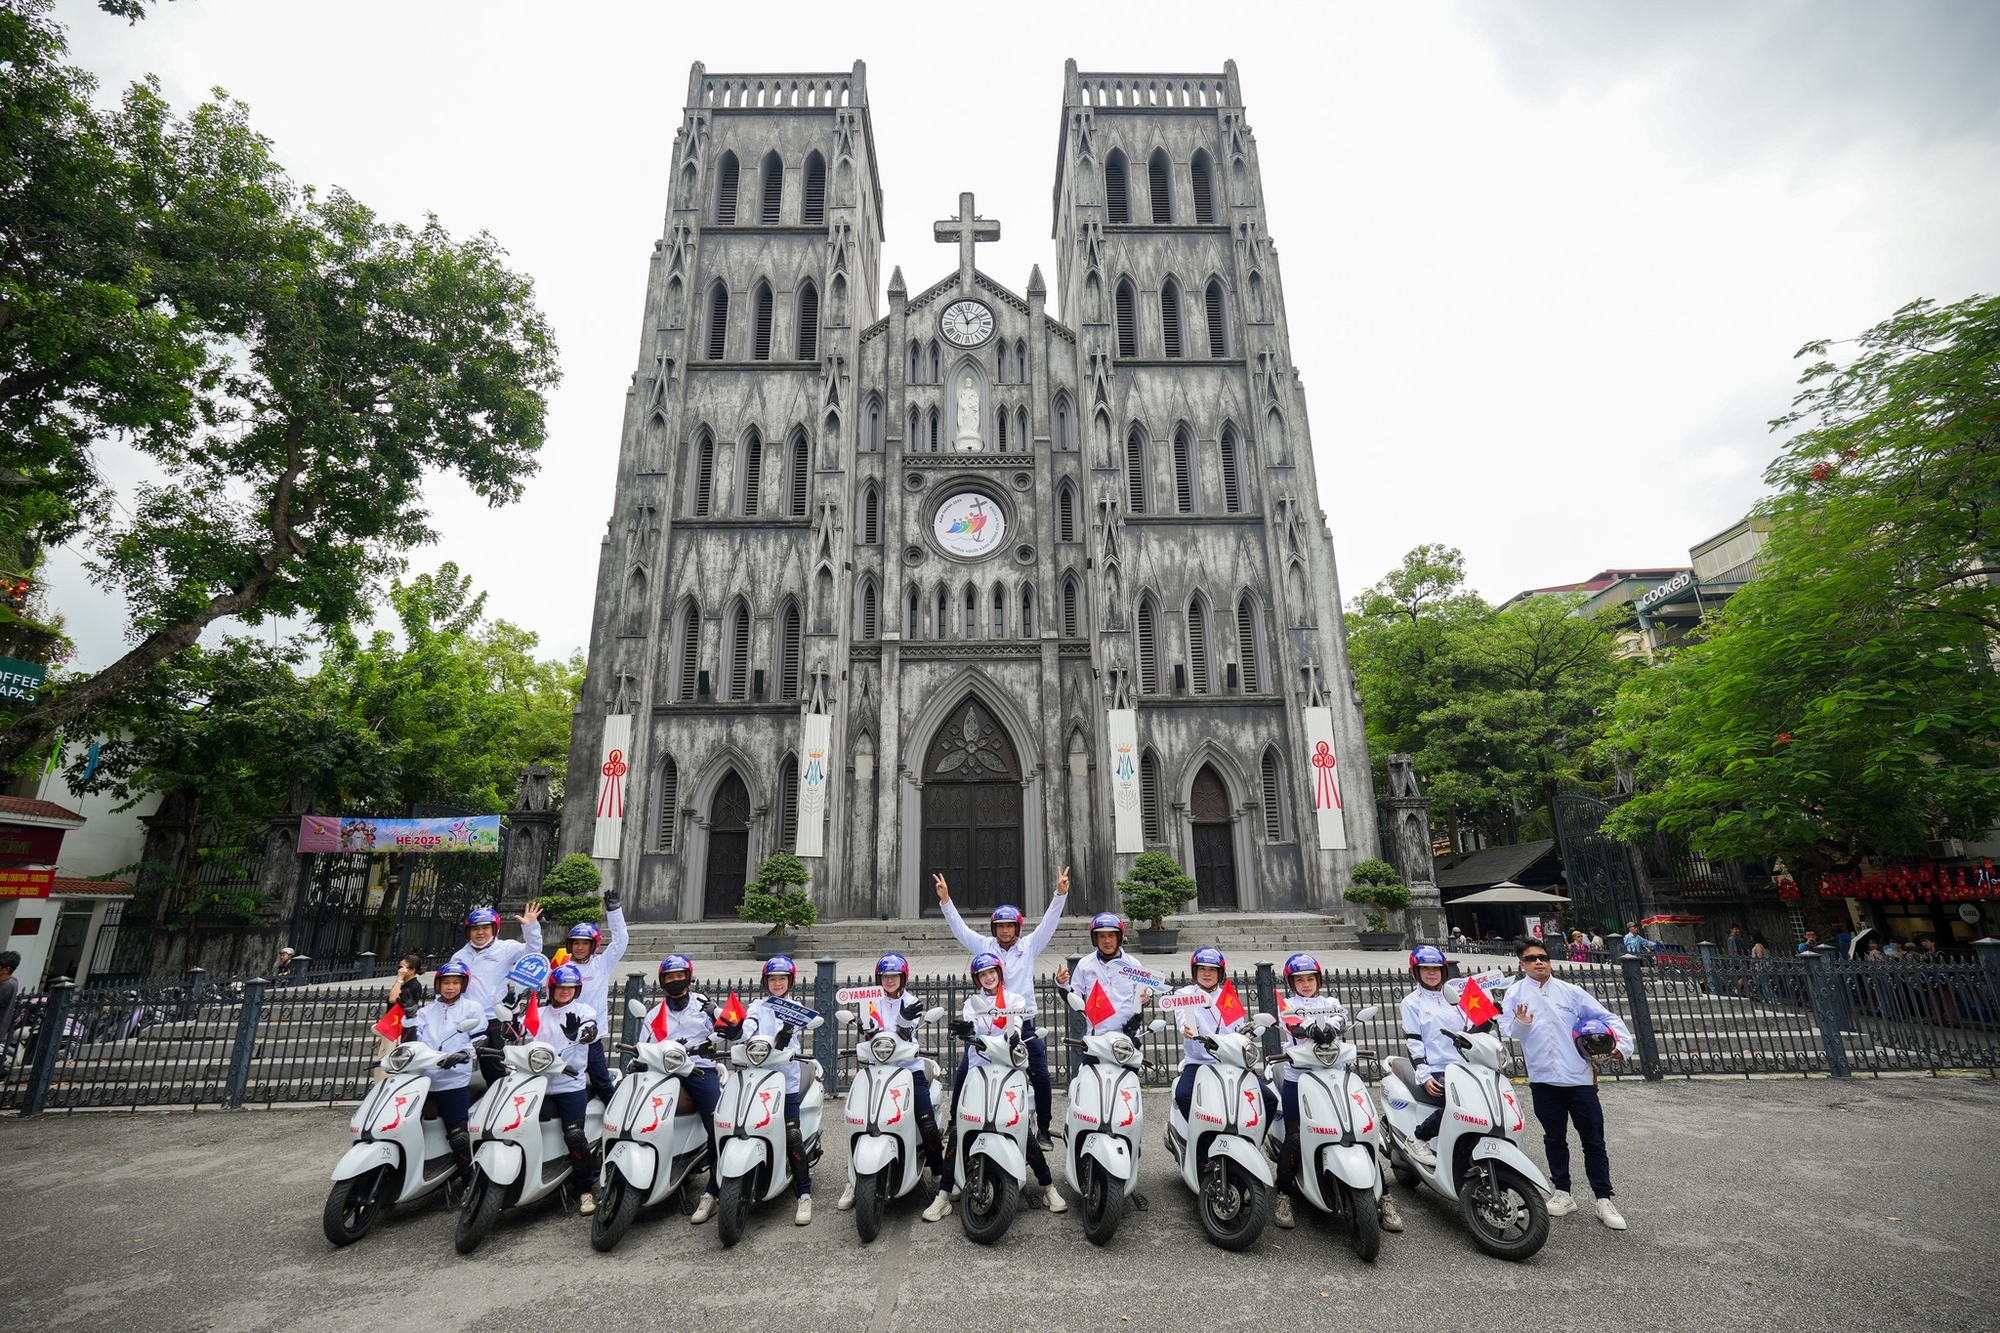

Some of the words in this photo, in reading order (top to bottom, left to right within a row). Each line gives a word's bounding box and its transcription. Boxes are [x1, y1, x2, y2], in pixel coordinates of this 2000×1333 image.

[0, 683, 35, 702] APAS
[396, 835, 411, 845] HÈ
[414, 836, 441, 845] 2025
[1122, 966, 1151, 978] GRANDE
[1128, 973, 1159, 986] TOURING
[1458, 976, 1488, 989] GRNDE
[849, 989, 882, 999] YAMAHA
[1171, 995, 1206, 1006] YAMAHA
[771, 1005, 806, 1019] CORE
[774, 1000, 810, 1014] BLUE
[978, 1007, 1033, 1018] Grande
[1284, 1006, 1344, 1017] Grande
[778, 1013, 804, 1025] Hybrid
[962, 1114, 981, 1123] YAMAHA
[1077, 1114, 1098, 1124] YAMAHA
[1200, 1114, 1223, 1125] YAMAHA
[1460, 1115, 1488, 1126] YAMAHA
[1312, 1126, 1338, 1135] YAMAHA
[1219, 1139, 1228, 1148] 70
[1487, 1142, 1496, 1150] 70
